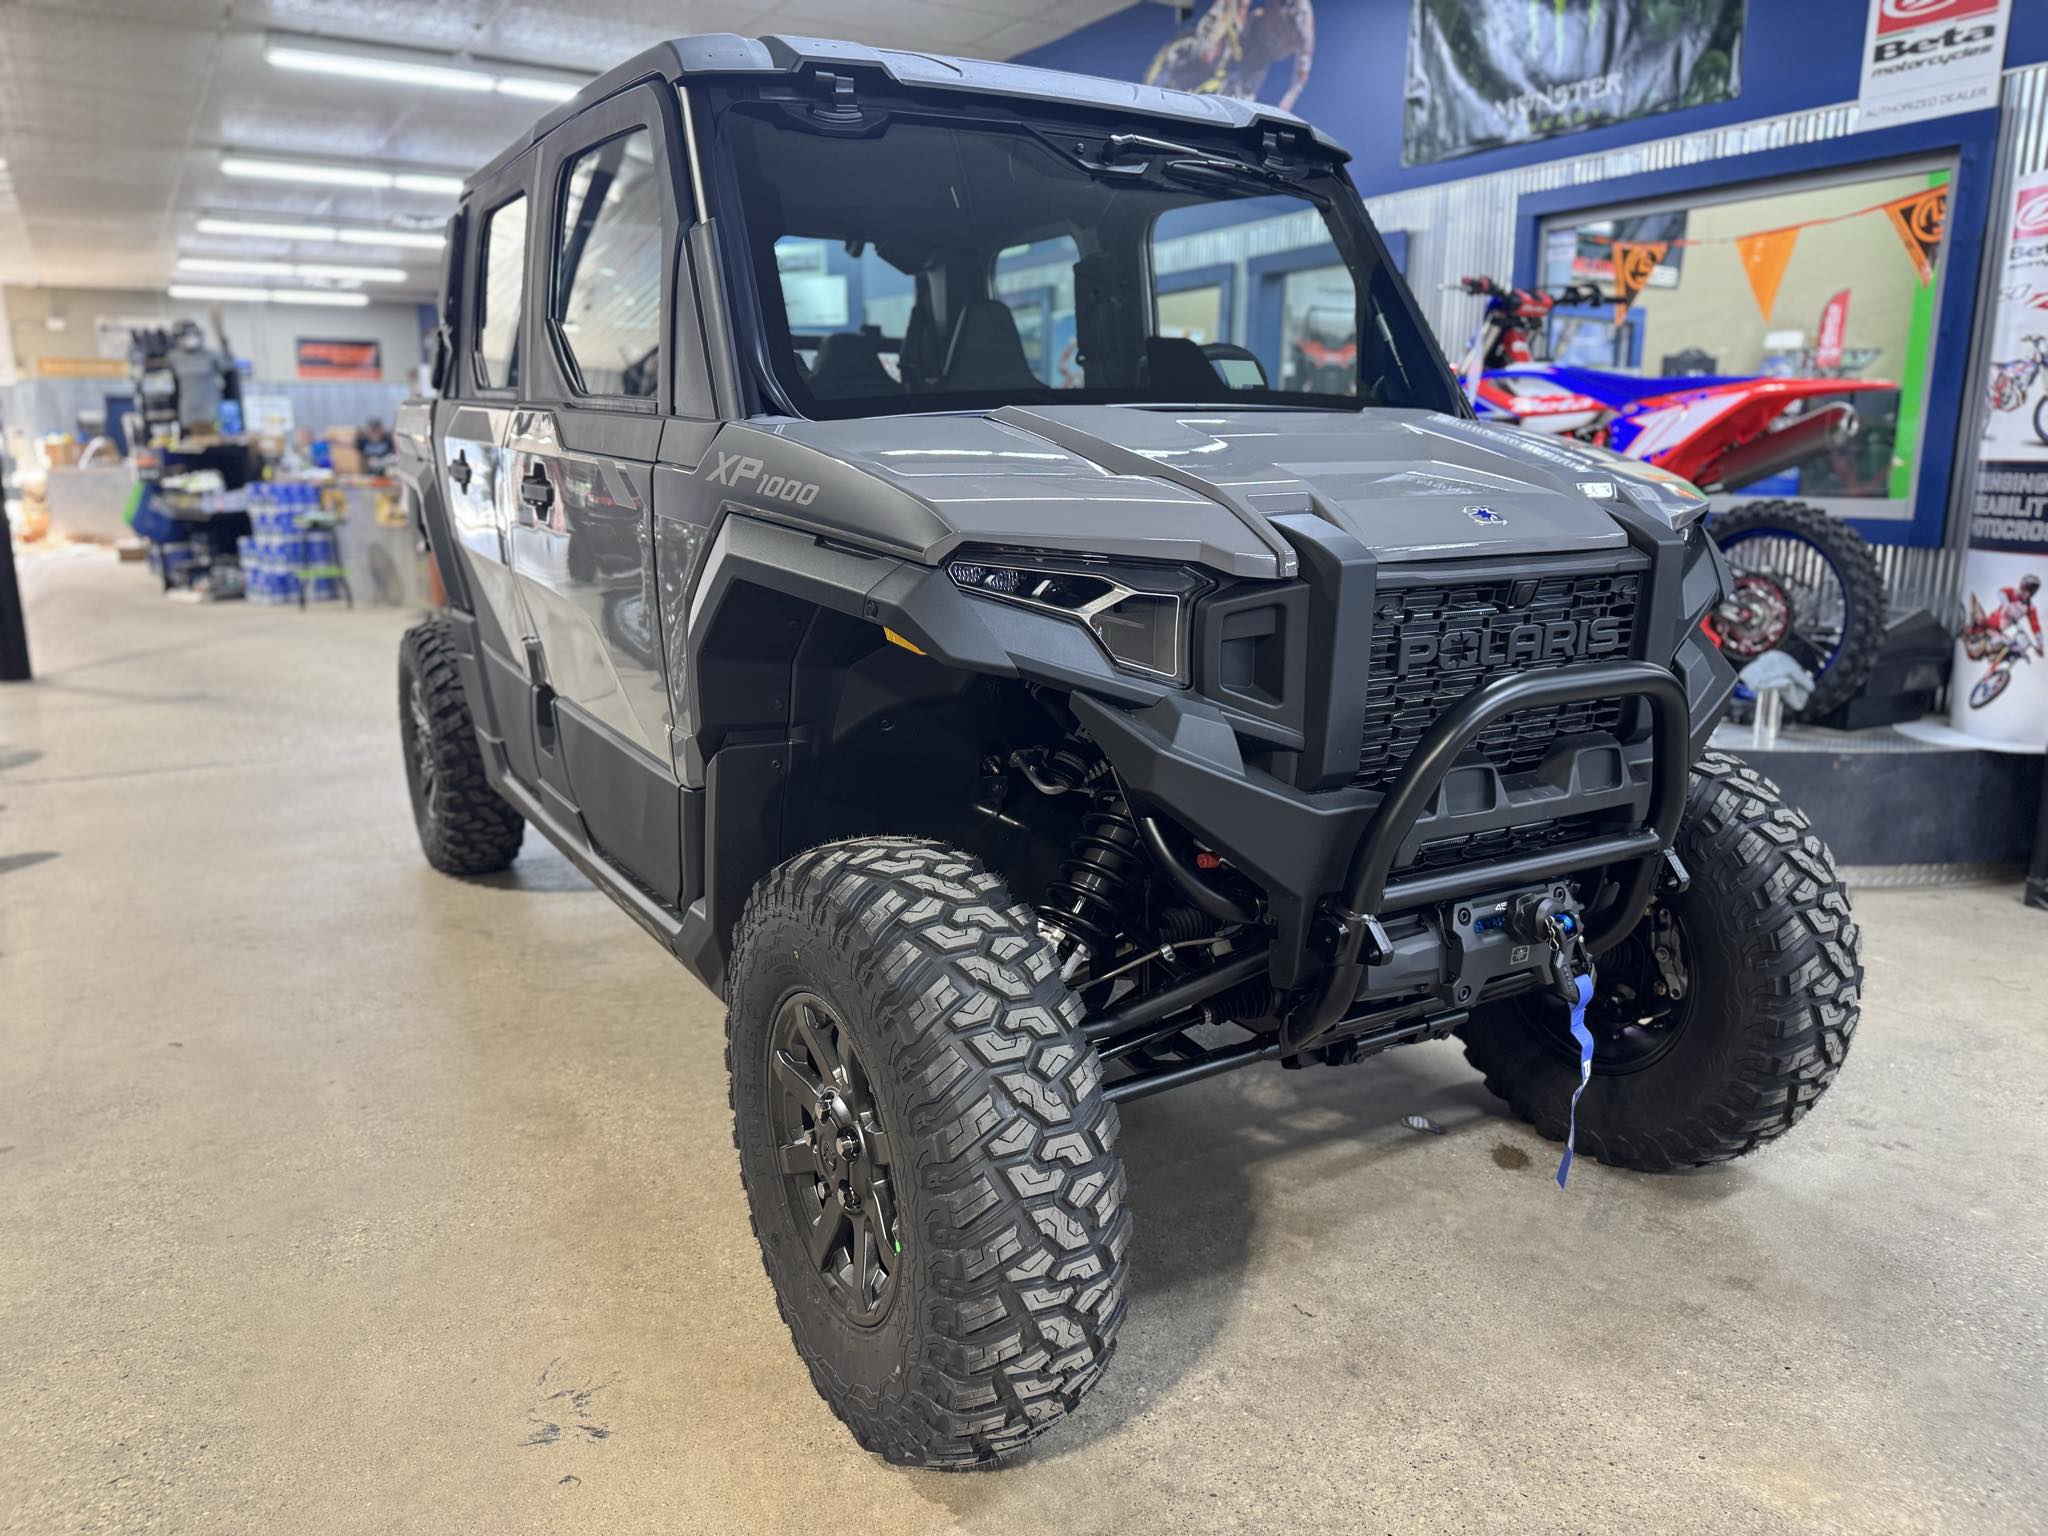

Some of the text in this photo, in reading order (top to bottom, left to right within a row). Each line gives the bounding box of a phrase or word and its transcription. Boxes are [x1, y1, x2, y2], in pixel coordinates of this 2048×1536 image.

[1871, 44, 1993, 78] motorcycles
[1873, 25, 1995, 63] Beta
[1495, 71, 1624, 120] MONSTER
[1865, 86, 1988, 119] AUTHORIZED DEALER
[1397, 616, 1619, 676] POLARIS
